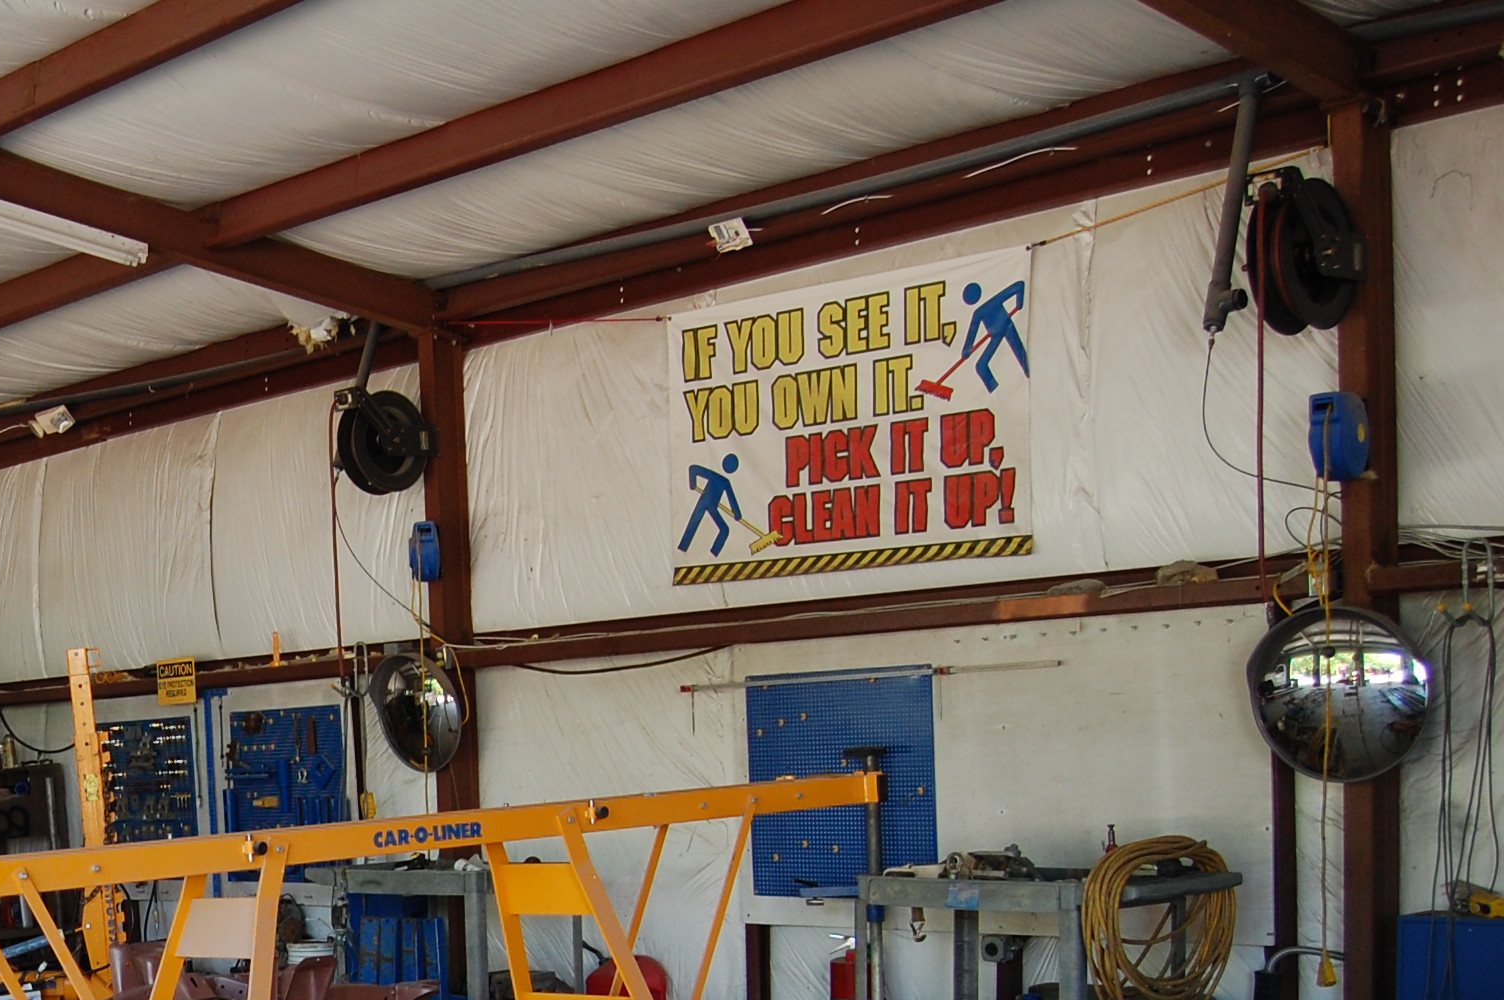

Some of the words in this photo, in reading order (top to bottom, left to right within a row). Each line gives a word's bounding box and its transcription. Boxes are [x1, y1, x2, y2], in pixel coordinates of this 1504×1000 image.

[682, 325, 717, 383] IF
[725, 308, 804, 374] YOU
[818, 291, 890, 358] SEE
[904, 281, 957, 346] IT,
[684, 380, 759, 443] YOU
[771, 363, 858, 430] OWN
[873, 354, 924, 417] IT.
[785, 424, 880, 488] PICK
[890, 417, 929, 475] IT
[940, 408, 1004, 469] UP,
[768, 484, 881, 547] CLEAN
[895, 478, 932, 535] IT
[944, 468, 1016, 529] UP!
[160, 662, 193, 678] CAUTION
[373, 821, 483, 849] CAR-O-LINER
